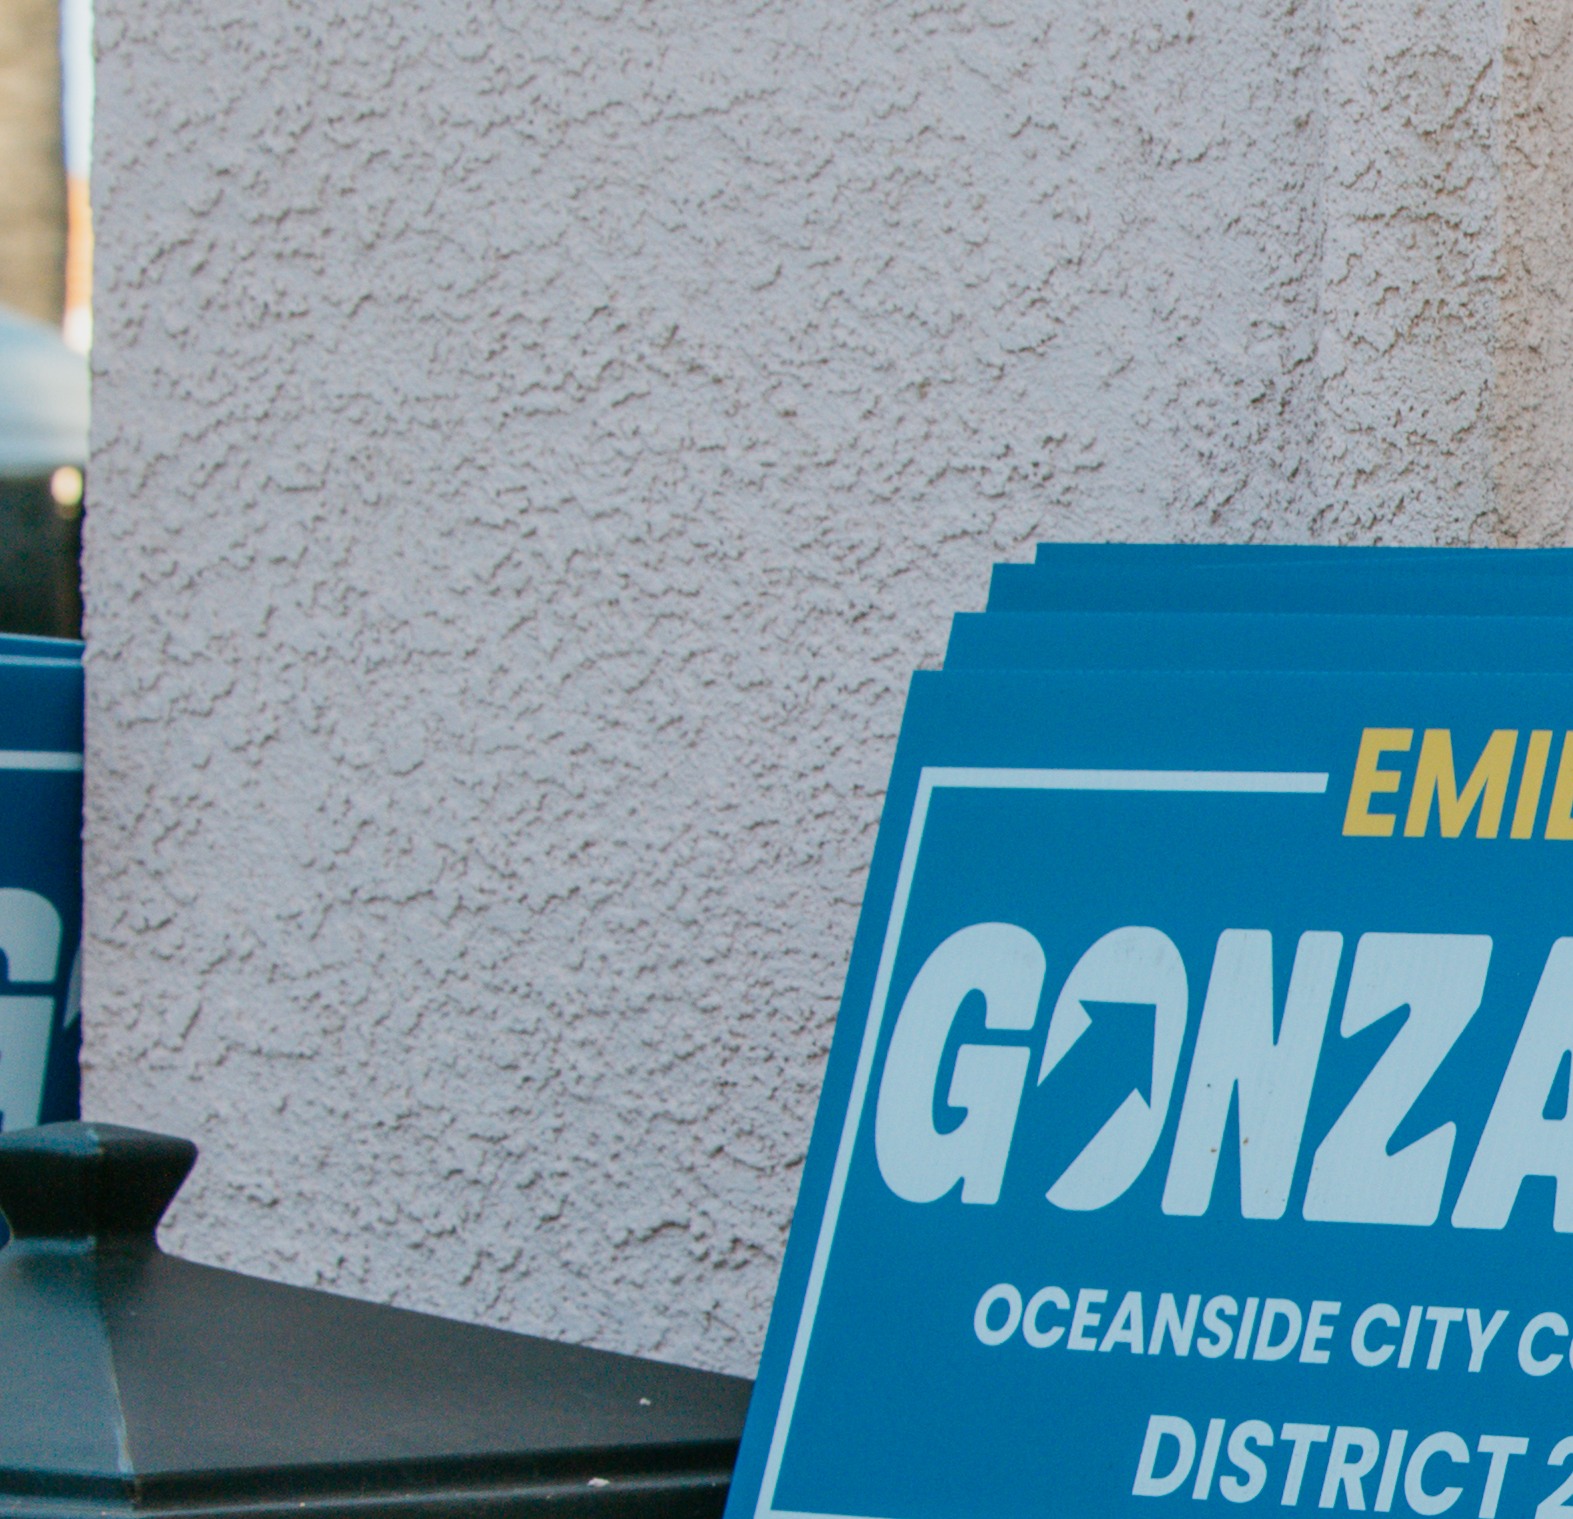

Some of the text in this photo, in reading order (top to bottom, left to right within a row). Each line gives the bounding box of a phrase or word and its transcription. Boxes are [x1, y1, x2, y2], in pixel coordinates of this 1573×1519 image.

[973, 1283, 1342, 1364] OCEANSIDE
[1350, 1303, 1510, 1373] CITY
[1131, 1414, 1530, 1519] DISTRICT
